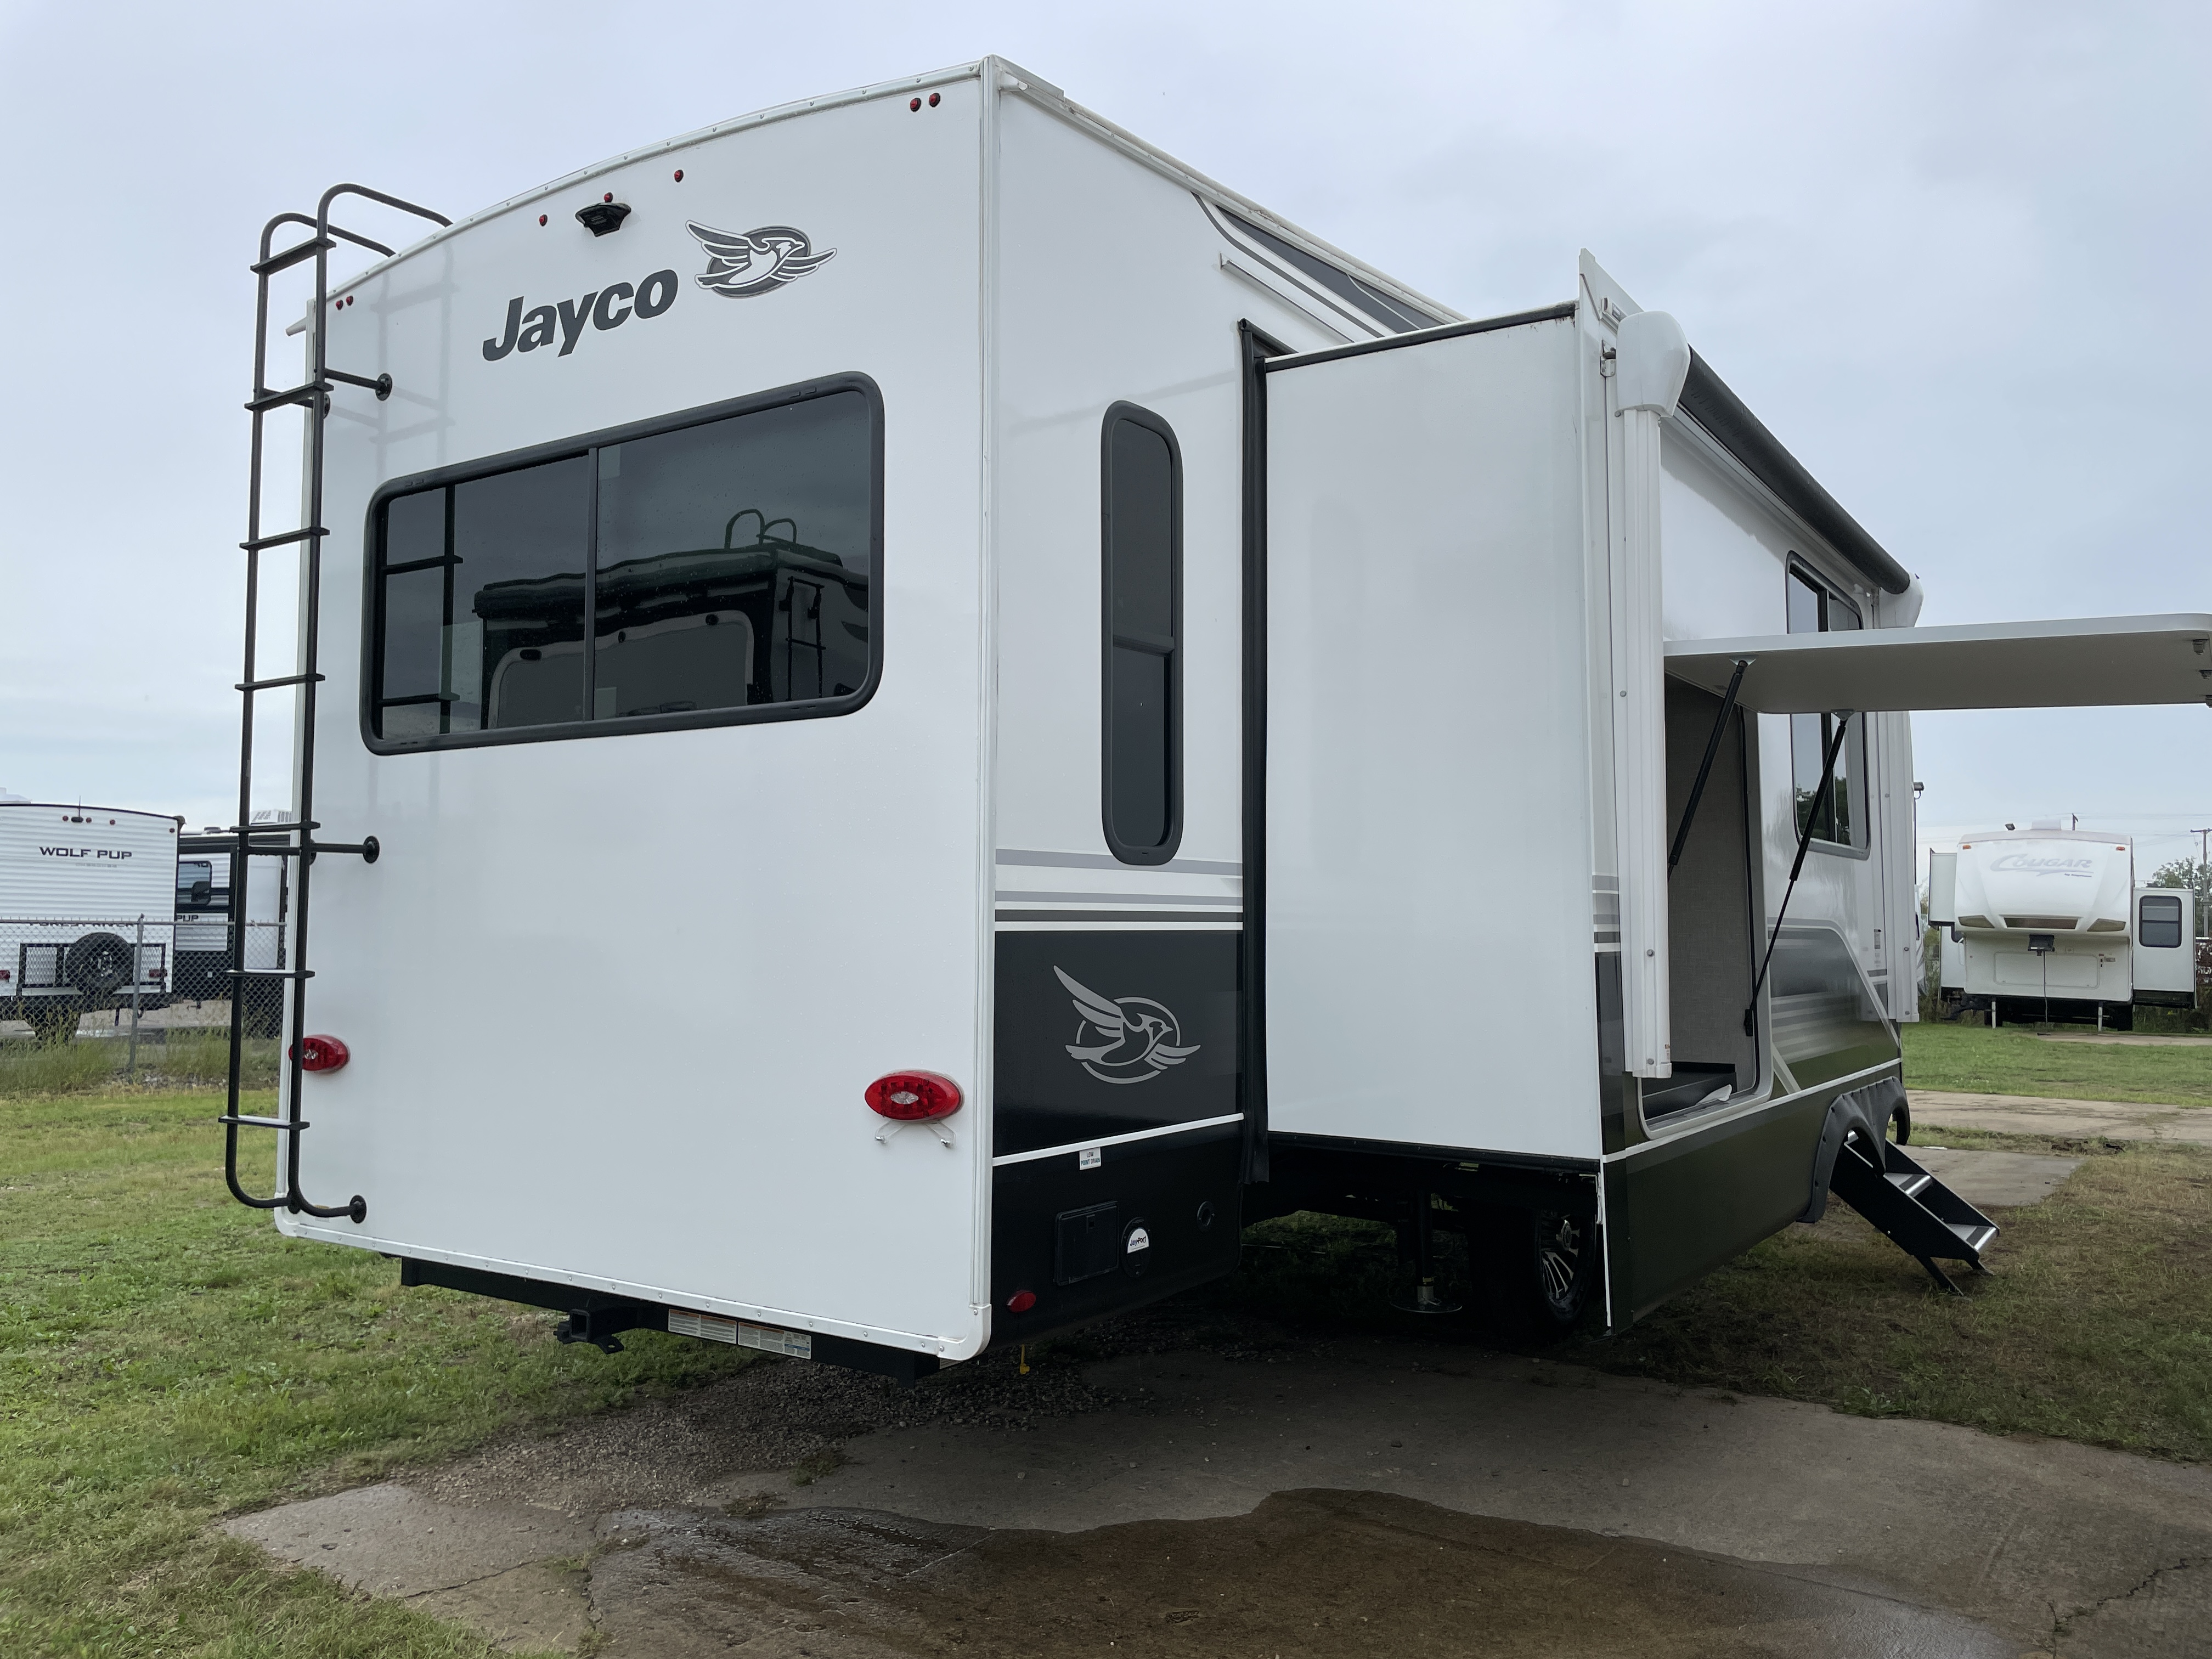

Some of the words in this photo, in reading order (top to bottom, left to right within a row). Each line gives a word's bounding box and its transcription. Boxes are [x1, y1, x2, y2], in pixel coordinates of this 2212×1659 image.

[482, 269, 678, 361] Jayco
[39, 847, 91, 857] WOLF
[97, 849, 132, 860] PUP
[1990, 853, 2093, 872] COUGAR
